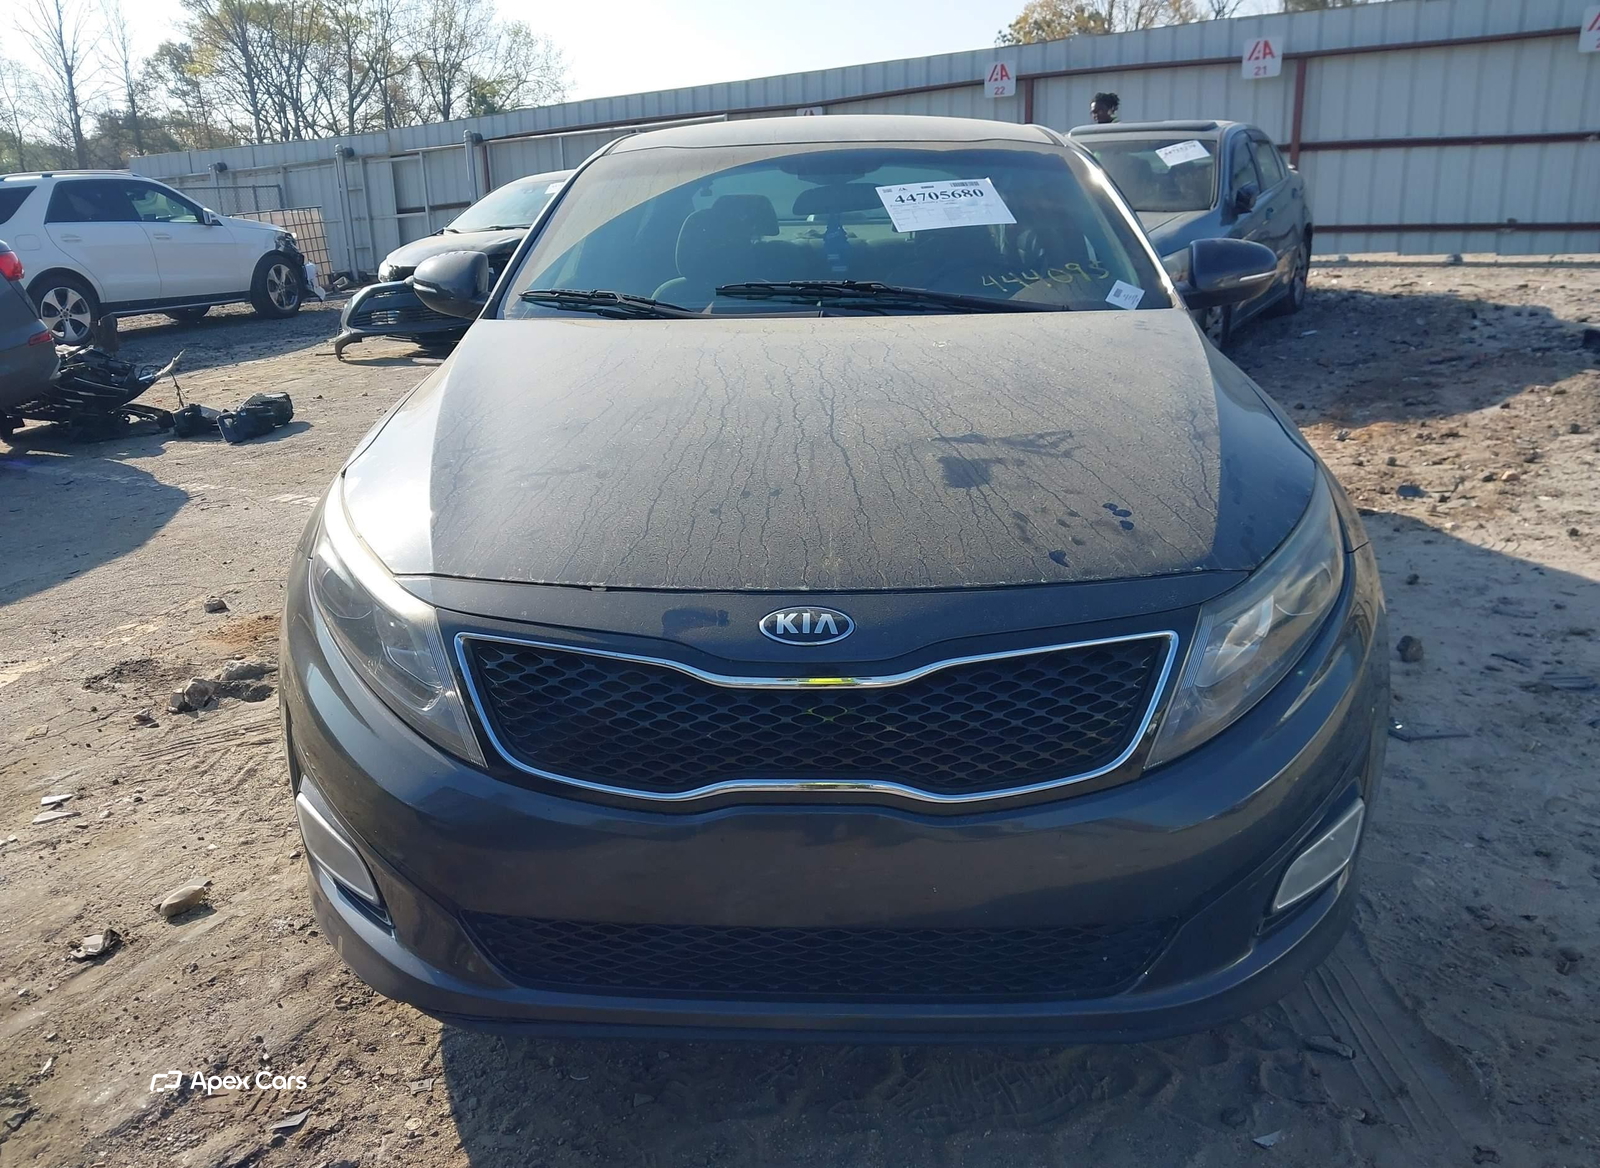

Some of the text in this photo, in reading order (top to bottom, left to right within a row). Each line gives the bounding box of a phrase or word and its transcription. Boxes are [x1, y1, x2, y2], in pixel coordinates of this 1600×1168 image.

[1254, 65, 1267, 76] 21
[994, 86, 1005, 95] 22
[894, 188, 984, 204] 44705680
[776, 612, 838, 635] KIA
